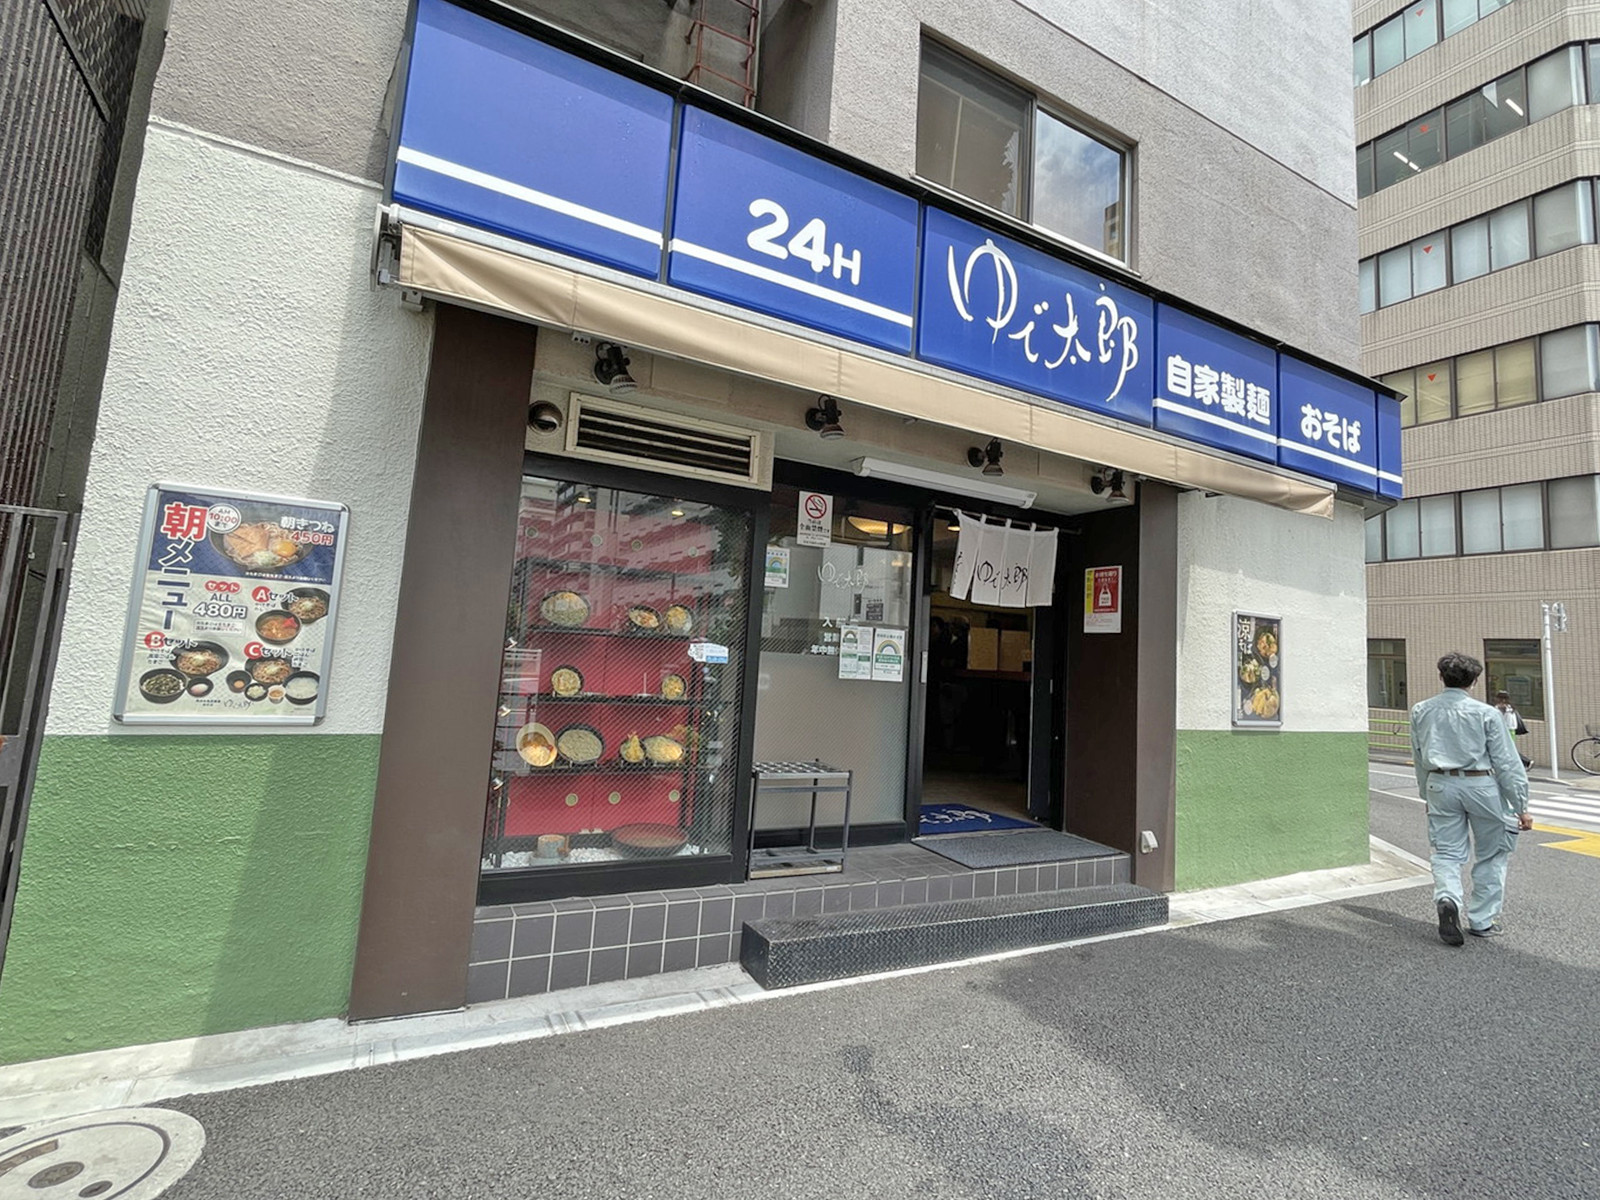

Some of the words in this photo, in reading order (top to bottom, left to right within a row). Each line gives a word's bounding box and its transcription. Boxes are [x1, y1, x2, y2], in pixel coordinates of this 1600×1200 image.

[747, 198, 861, 286] 24H
[947, 238, 1139, 402] ゆで太郎
[1166, 354, 1271, 426] 自家製麺
[1300, 403, 1362, 454] おそば
[208, 511, 238, 524] 10:00
[280, 515, 335, 533] 朝きつね
[291, 530, 334, 545] 450円
[817, 561, 868, 594] ゆで太郎
[977, 560, 1028, 592] ゆで太郎
[206, 581, 239, 592] セット
[210, 593, 232, 602] ALL
[194, 602, 247, 619] 480円
[920, 809, 992, 824] で太郎
